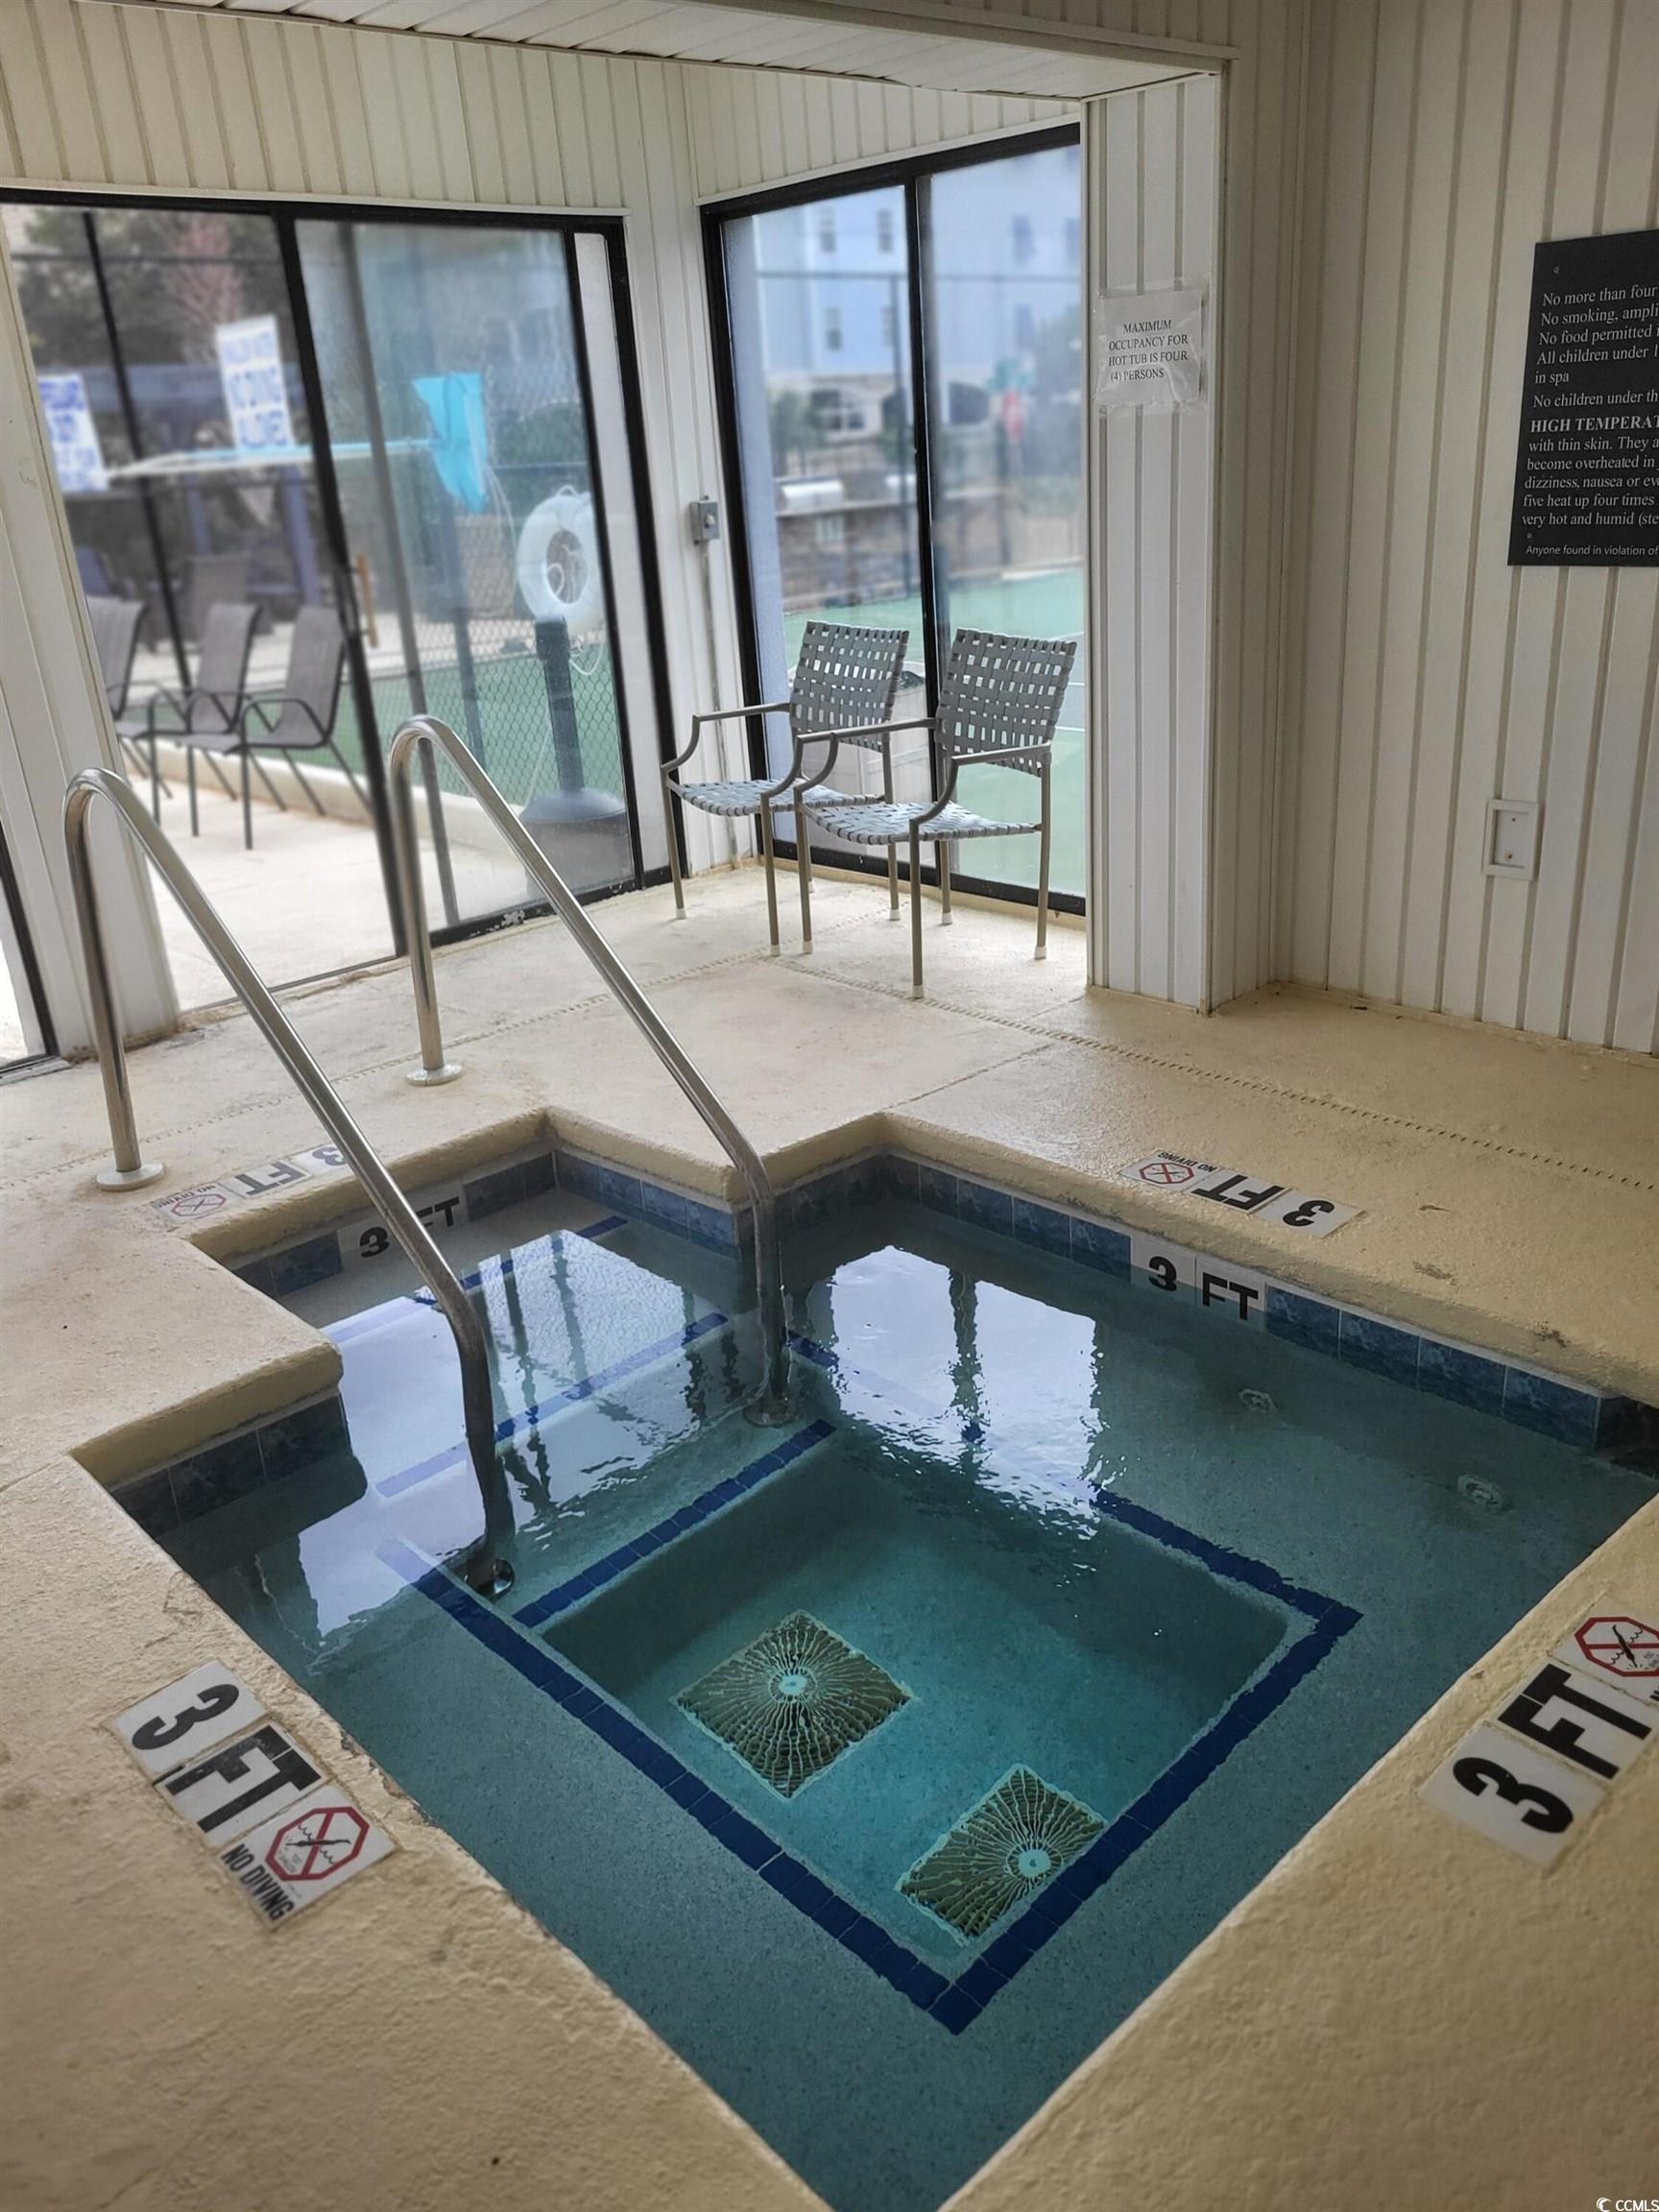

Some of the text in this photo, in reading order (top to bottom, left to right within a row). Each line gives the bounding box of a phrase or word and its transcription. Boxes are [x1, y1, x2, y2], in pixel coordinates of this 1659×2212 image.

[1543, 285, 1658, 306] No more than four
[1541, 312, 1559, 326] No
[1562, 308, 1619, 324] smoking,
[1123, 319, 1172, 334] MAXIMUM
[1539, 331, 1557, 346] No
[1561, 328, 1589, 344] food
[1592, 324, 1652, 345] permitted
[1109, 334, 1189, 351] OCCUPANCY FOR
[1109, 350, 1189, 367] HOT TUB IS FOUR
[1536, 350, 1556, 365] All
[1559, 348, 1609, 364] children
[1612, 345, 1649, 360] under
[1110, 371, 1121, 382] (4)
[1535, 371, 1570, 386] in spa
[1533, 395, 1551, 408] No
[1554, 393, 1603, 407] children
[1607, 390, 1644, 404] under
[1530, 419, 1571, 433] HIGH
[1528, 439, 1554, 452] with
[1557, 437, 1580, 451] thin
[1584, 437, 1613, 450] skin.
[1618, 436, 1648, 451] They
[1527, 454, 1655, 470] become overheated in
[1525, 475, 1580, 490] dizziness,
[1583, 477, 1623, 488] nausea
[1626, 477, 1641, 488] or
[1523, 493, 1655, 510] five heat up four times
[1522, 515, 1546, 528] very
[1549, 512, 1567, 525] hot
[1570, 512, 1592, 525] and
[1596, 512, 1634, 525] humid
[1526, 545, 1659, 557] Anyone found in violation of
[1158, 1152, 1217, 1172] NO DIVING
[235, 1162, 306, 1195] FT
[1190, 1174, 1335, 1227] 3 FT
[360, 1226, 390, 1258] 3
[1148, 1256, 1259, 1321] 3 FT
[1453, 1663, 1652, 1834] 3 FT
[132, 1684, 322, 1834] 3 FT
[220, 1843, 254, 1871] NO
[240, 1864, 295, 1920] DIVING
